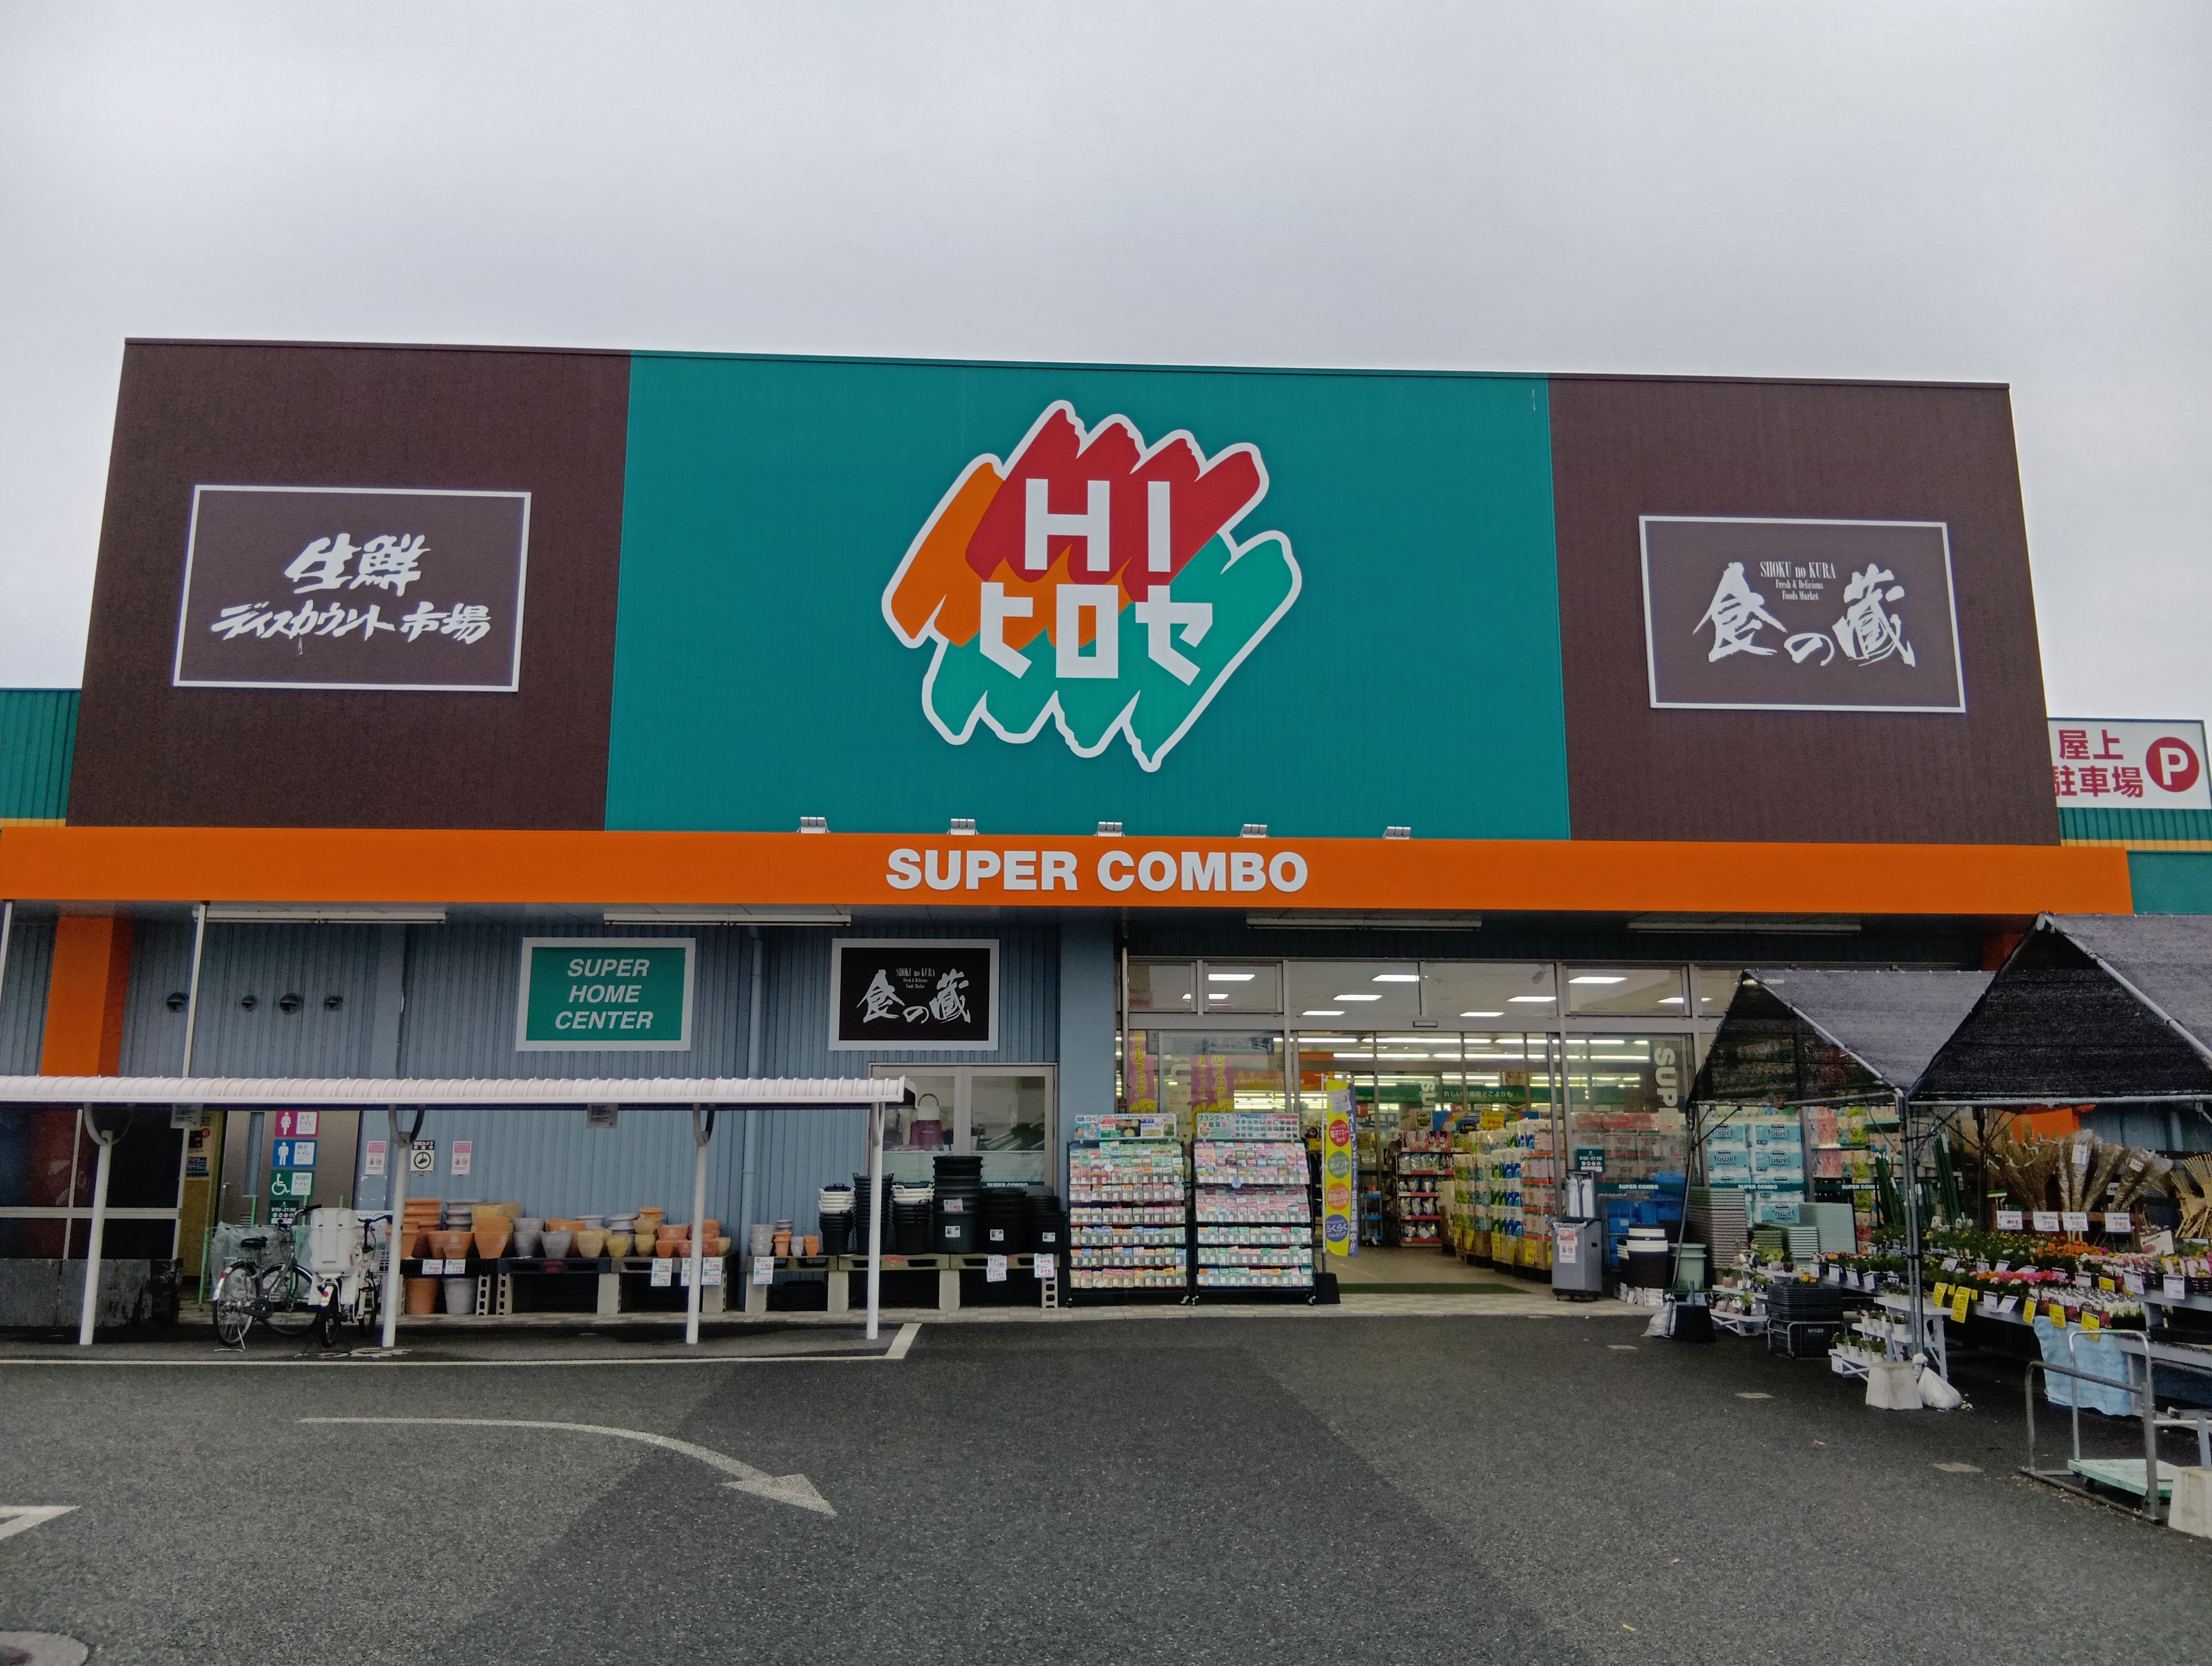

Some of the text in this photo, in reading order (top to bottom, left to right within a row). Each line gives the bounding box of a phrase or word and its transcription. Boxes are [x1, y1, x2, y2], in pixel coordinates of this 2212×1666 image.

[1025, 478, 1171, 572] HI
[284, 533, 432, 597] 生鮮
[1760, 561, 1837, 579] SHOKU no KURA
[1775, 579, 1791, 589] Fresh
[1792, 580, 1797, 589] &
[1782, 590, 1819, 600] Foods Market
[211, 599, 493, 644] ディスカウント市場
[1692, 562, 1916, 667] 食の蔵
[980, 581, 1213, 686] ヒロセ
[2058, 729, 2124, 760] 屋上
[2052, 765, 2144, 798] 駐車場
[2159, 747, 2189, 785] P
[885, 848, 1309, 893] SUPER COMBO
[567, 958, 651, 977] SUPER
[568, 984, 642, 1003] HOME
[856, 968, 971, 1024] 食の蔵
[555, 1011, 654, 1030] CENTER
[1329, 1160, 1349, 1169] ポイント
